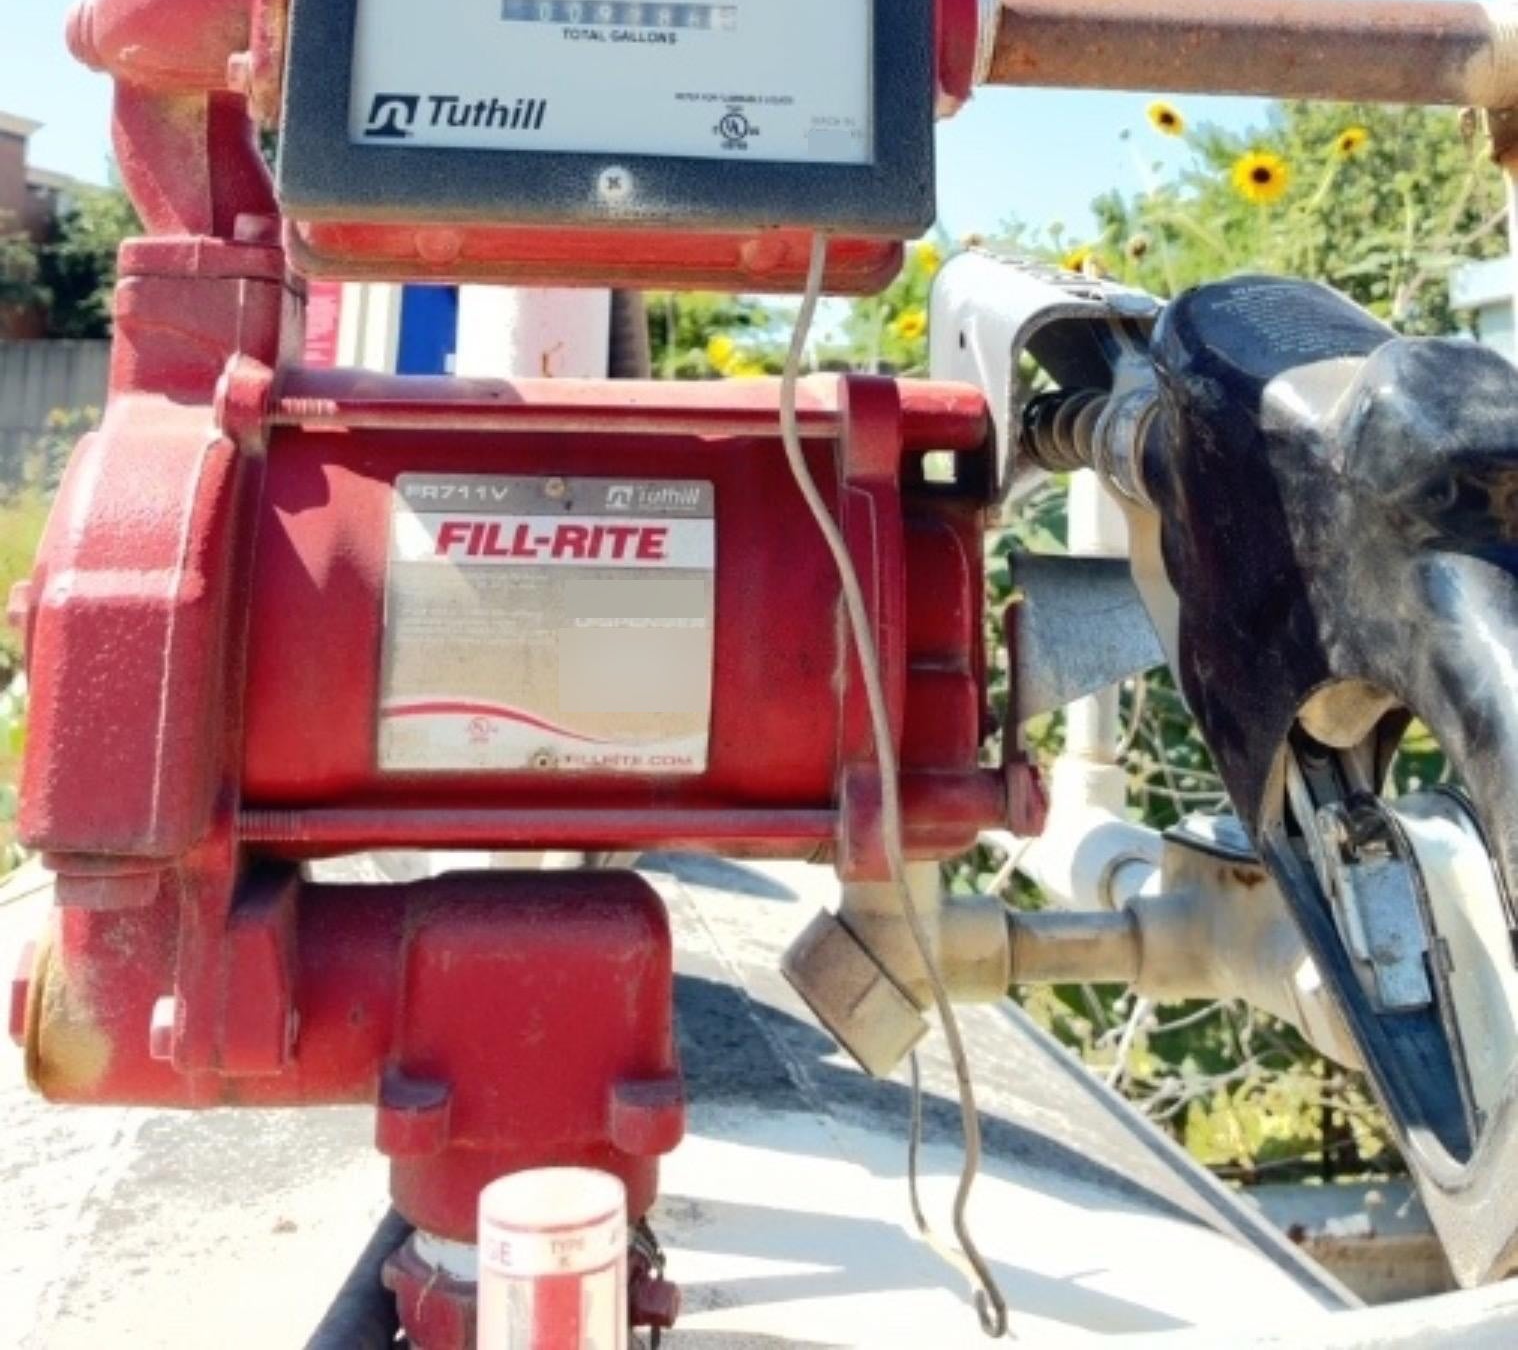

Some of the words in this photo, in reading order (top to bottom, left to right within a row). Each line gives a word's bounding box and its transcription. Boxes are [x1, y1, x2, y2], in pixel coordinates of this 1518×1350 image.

[562, 28, 606, 43] TOTAL
[610, 30, 678, 45] GALLONS
[428, 94, 547, 130] Tuthill
[434, 521, 668, 560] FILL-RITE
